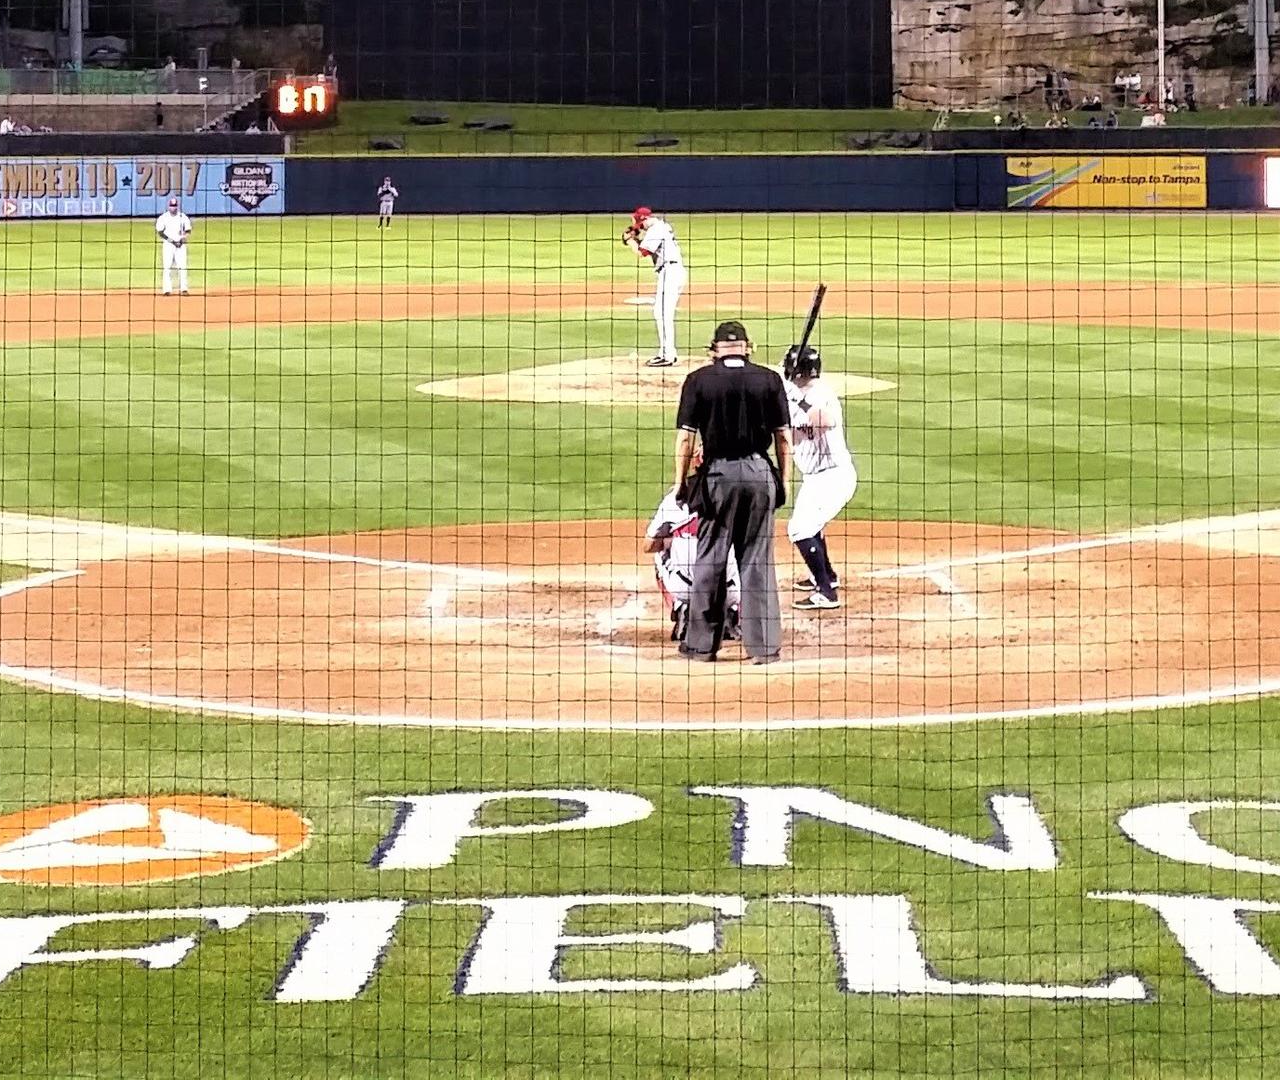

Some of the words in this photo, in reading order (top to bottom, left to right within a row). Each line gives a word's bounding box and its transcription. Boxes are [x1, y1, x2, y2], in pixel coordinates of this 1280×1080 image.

[86, 162, 117, 198] 19
[135, 160, 201, 197] 2017
[1093, 174, 1146, 186] Non-stop
[1148, 174, 1160, 184] to
[1161, 174, 1201, 185] Tampa
[21, 199, 57, 216] PNC
[64, 199, 113, 216] FIELD
